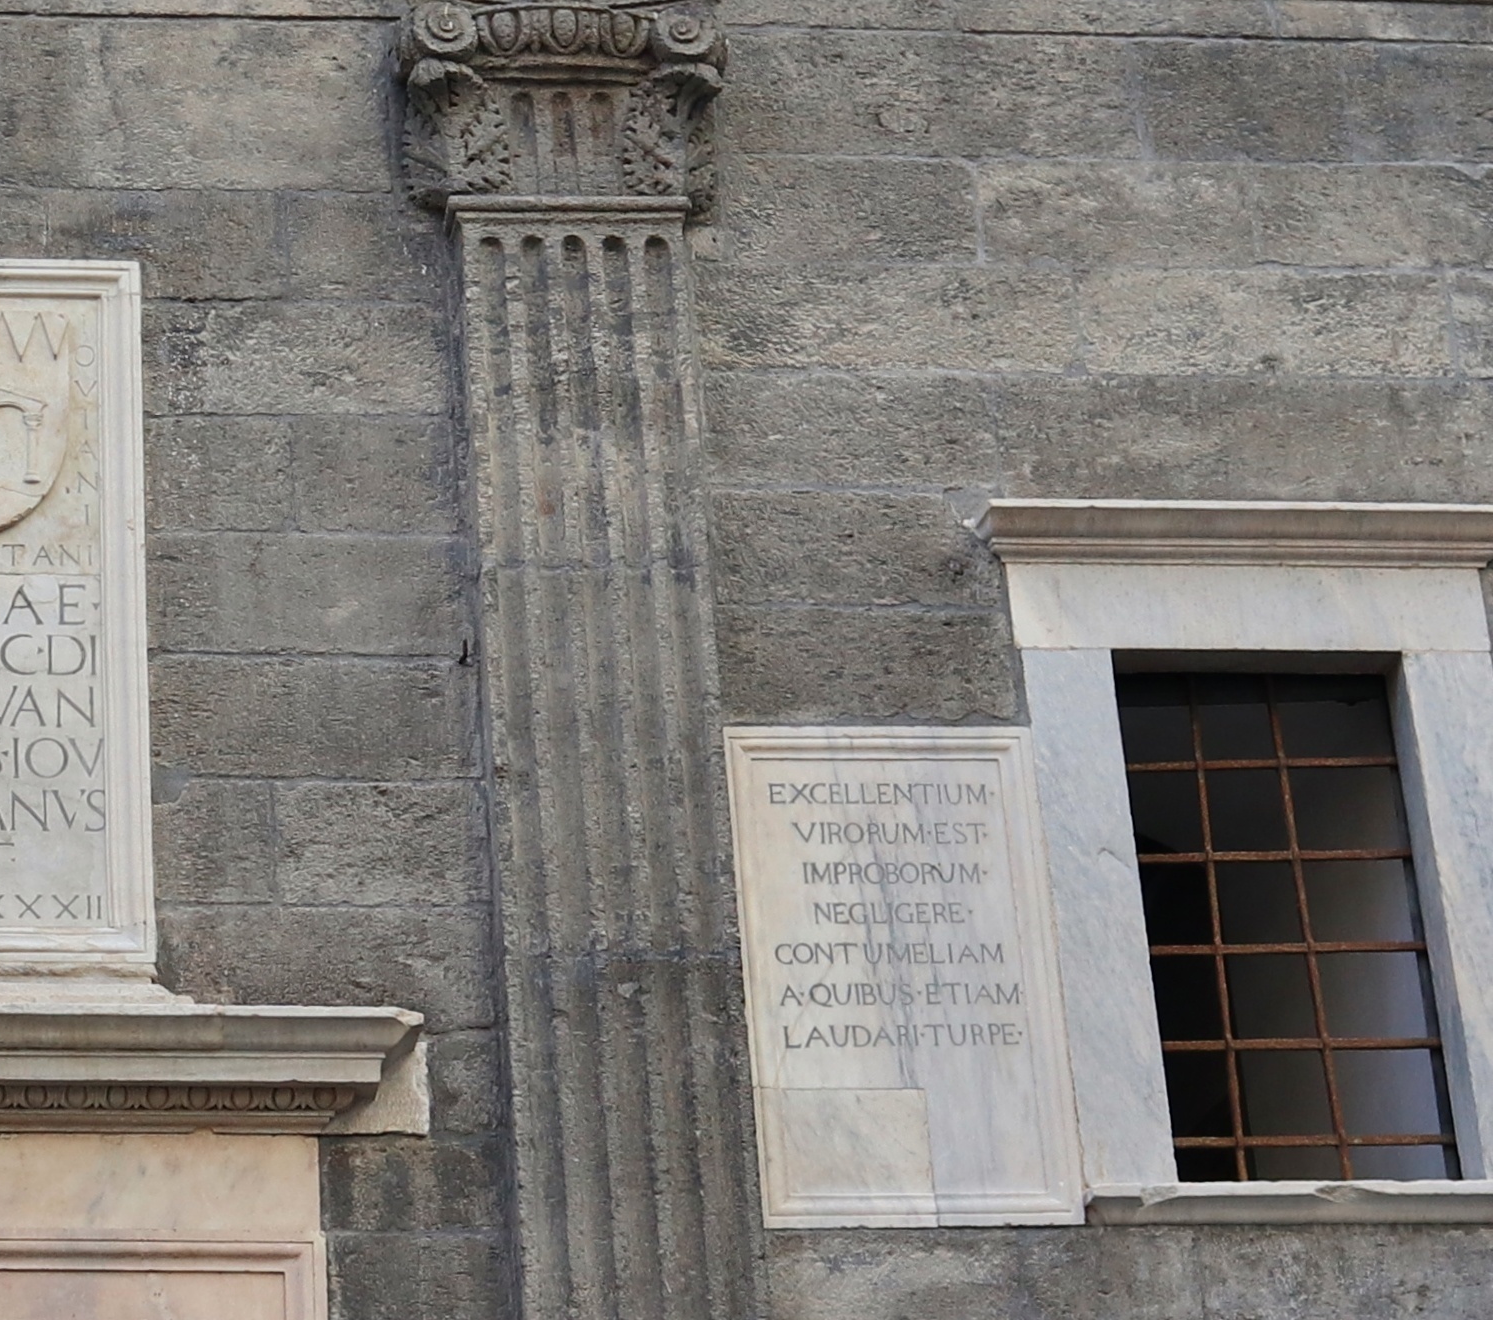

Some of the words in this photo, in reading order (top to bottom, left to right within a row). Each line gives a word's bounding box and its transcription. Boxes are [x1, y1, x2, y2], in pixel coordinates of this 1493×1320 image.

[46, 634, 98, 676] DI
[13, 737, 105, 779] IOV
[768, 782, 989, 805] EXCELLENTIUM
[792, 822, 925, 845] VIRORUM
[934, 822, 986, 845] EST
[802, 861, 982, 885] IMPROBORUM
[813, 902, 965, 925] NEGLIGERE
[774, 942, 1005, 966] CONTUMELIAM
[779, 983, 804, 1007] A
[808, 982, 914, 1008] QUIBUS
[925, 982, 1021, 1005] ETIAM
[782, 1024, 919, 1049] LAUDARI
[922, 1023, 1019, 1047] TURPE
